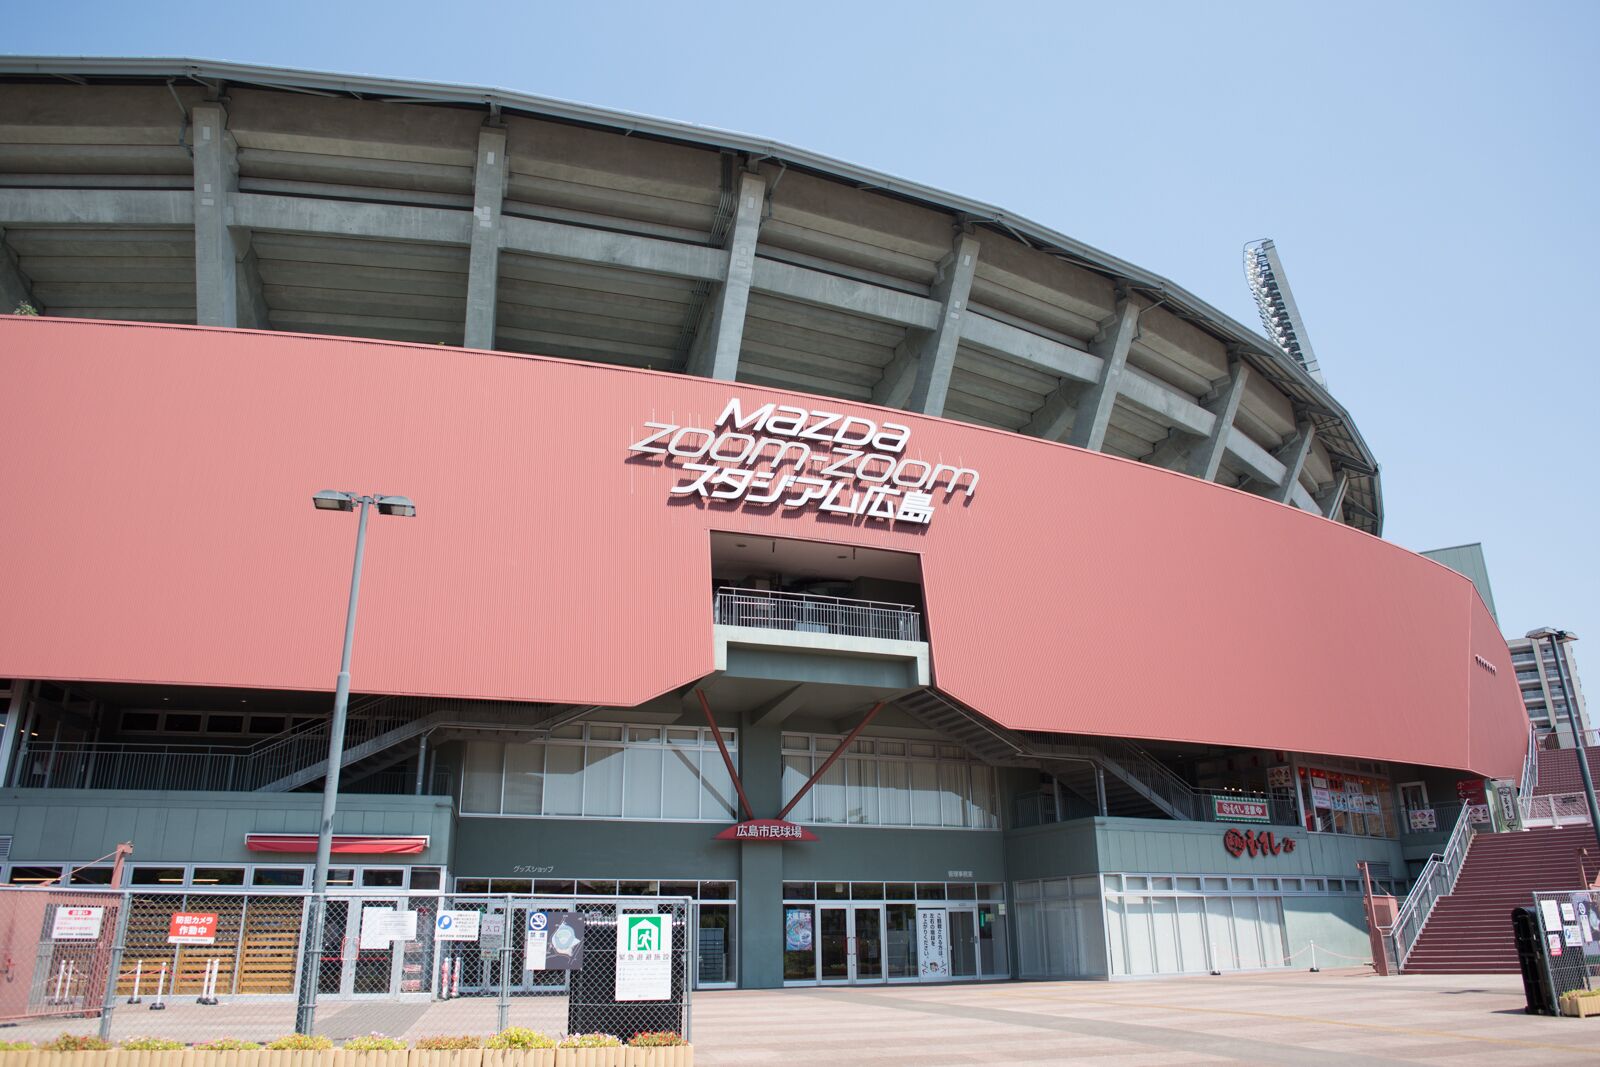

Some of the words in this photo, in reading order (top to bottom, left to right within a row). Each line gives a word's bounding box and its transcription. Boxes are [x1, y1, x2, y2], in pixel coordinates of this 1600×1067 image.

[669, 462, 936, 524] スタジアム広島
[736, 824, 802, 839] 広島市民球場
[512, 864, 555, 874] グッズショップ
[175, 915, 214, 925] 防犯カメラ
[178, 925, 208, 935] 作動中
